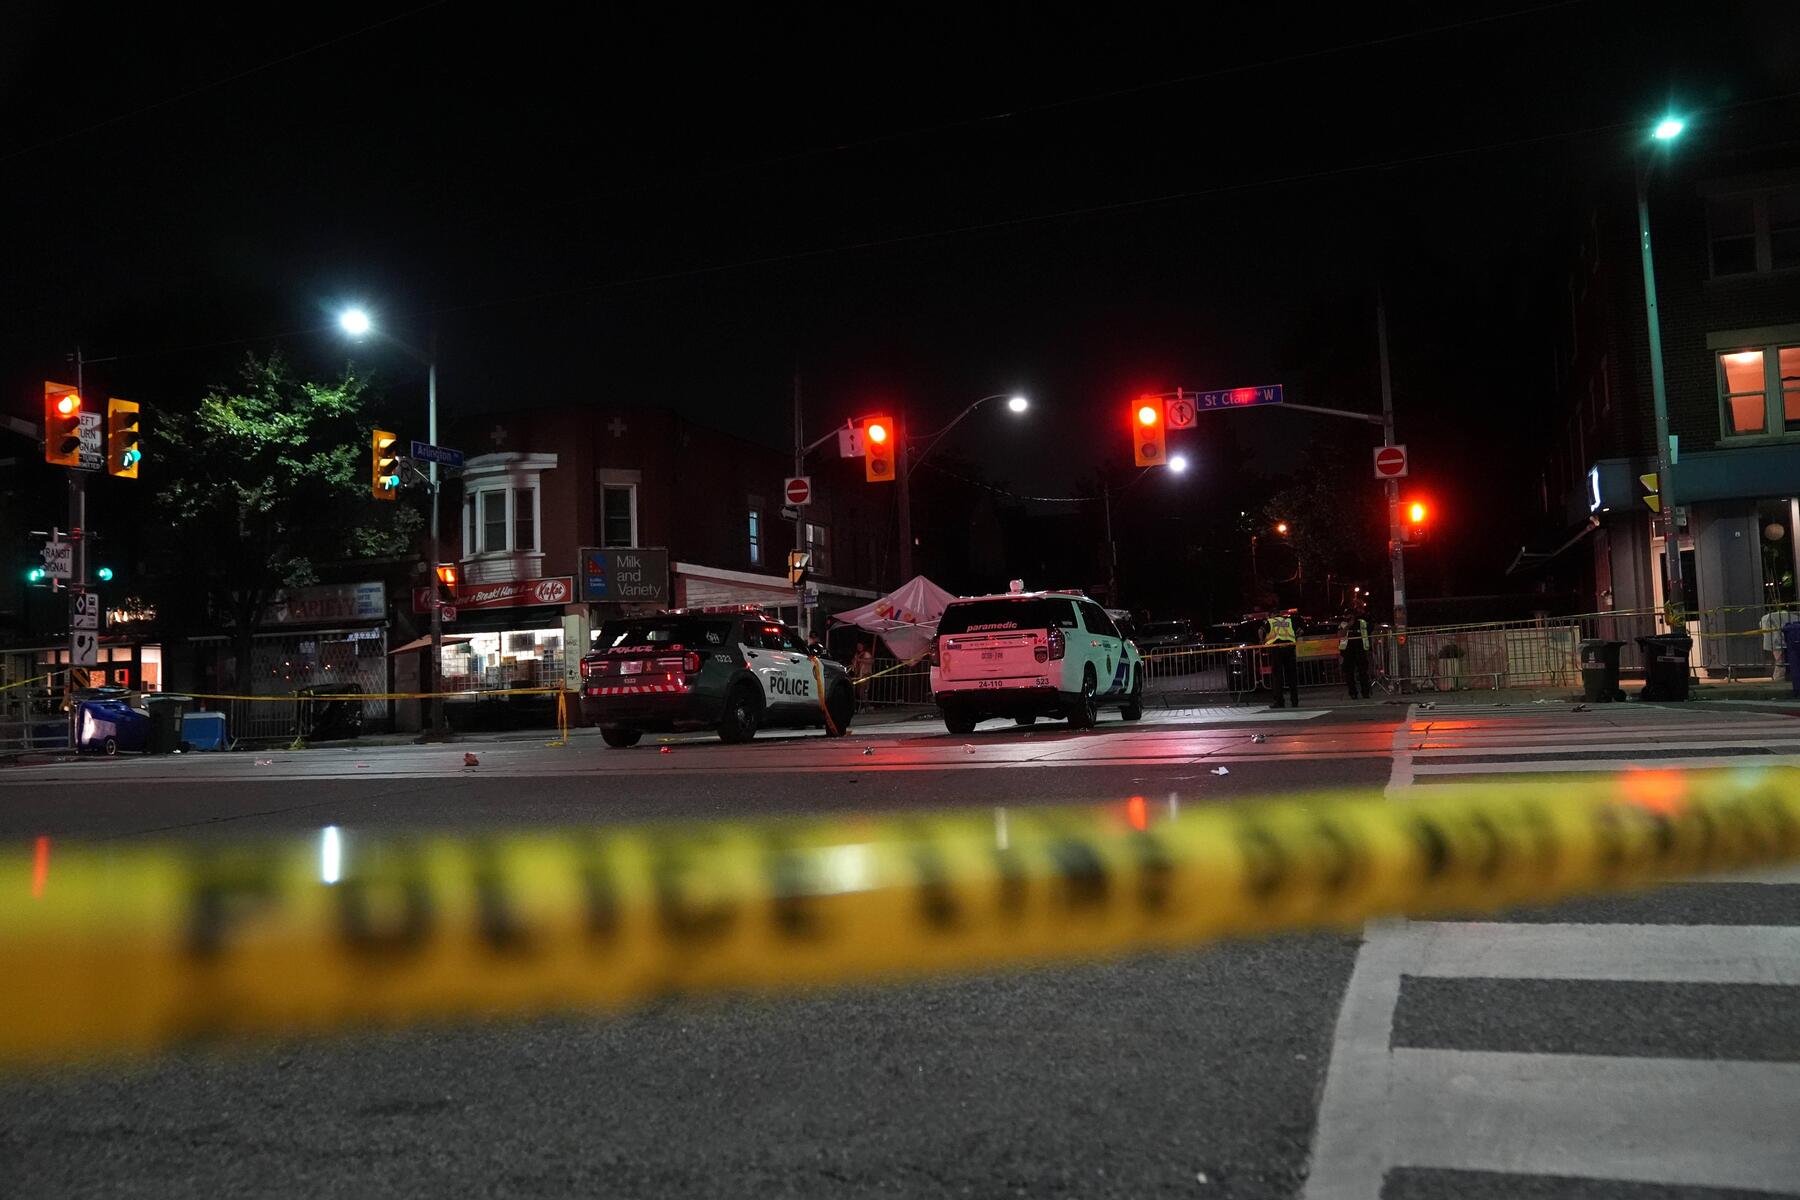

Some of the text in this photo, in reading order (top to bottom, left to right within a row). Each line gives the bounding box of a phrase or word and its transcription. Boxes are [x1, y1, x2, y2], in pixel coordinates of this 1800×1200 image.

[1204, 394, 1216, 407] St
[1221, 389, 1250, 405] Clair
[1263, 388, 1274, 401] W
[80, 415, 95, 427] EFT
[80, 428, 97, 440] URN
[79, 441, 98, 453] GNAL
[616, 555, 641, 568] Milk
[616, 568, 641, 582] and
[476, 587, 502, 601] Break!
[617, 583, 662, 599] Variety
[966, 621, 1019, 633] paramedic
[608, 645, 655, 655] POLICE
[770, 676, 810, 697] POLICE
[1035, 678, 1050, 686] 523
